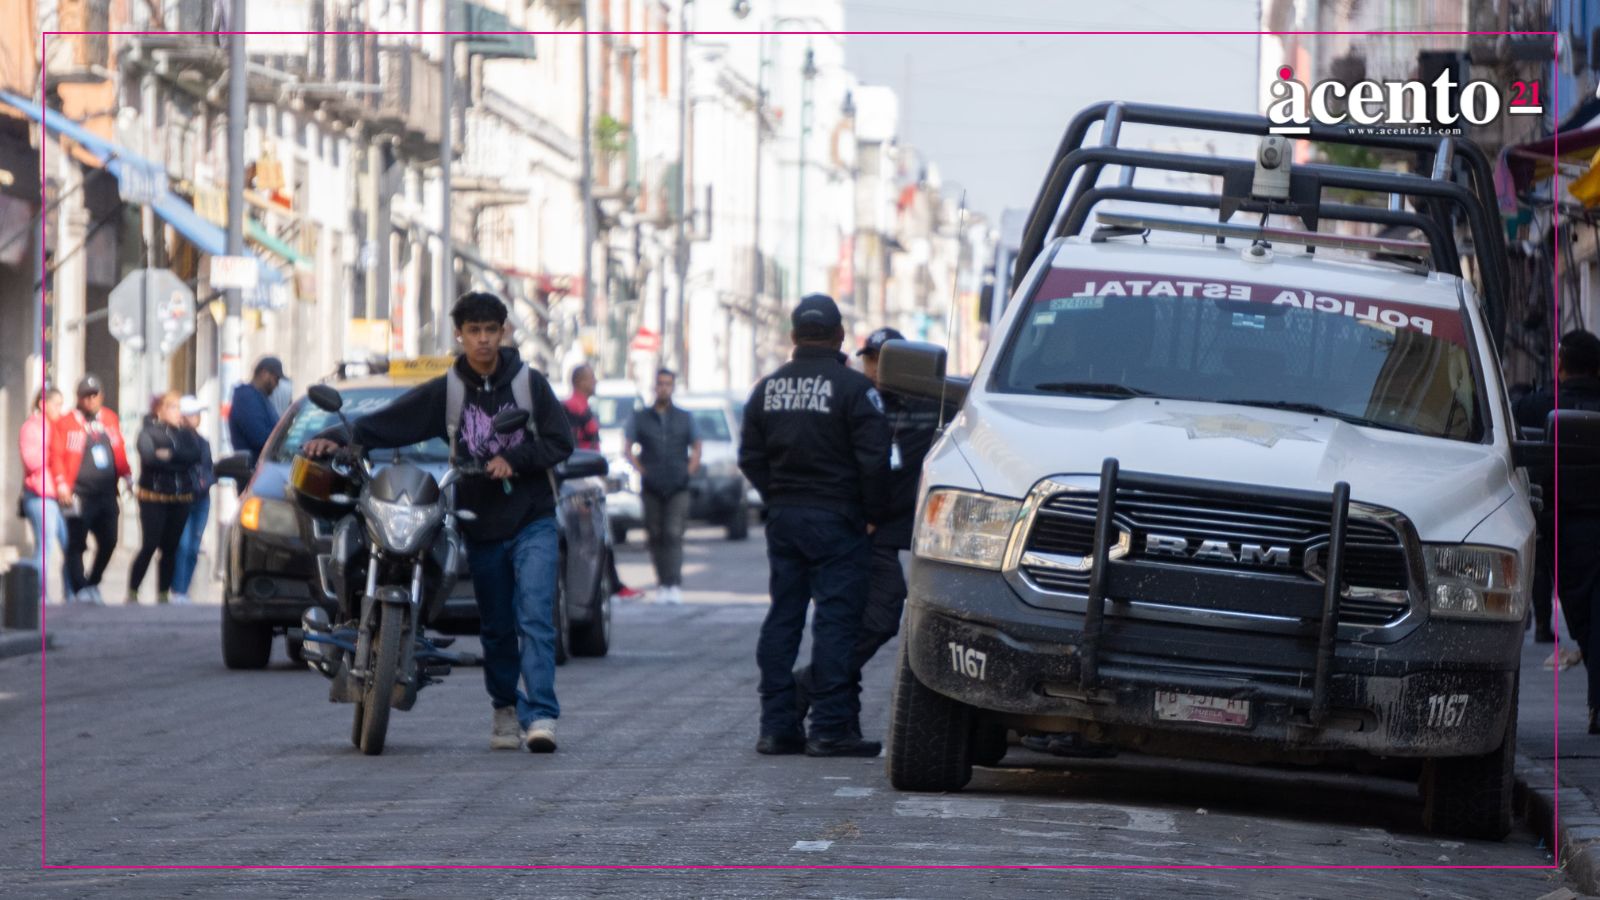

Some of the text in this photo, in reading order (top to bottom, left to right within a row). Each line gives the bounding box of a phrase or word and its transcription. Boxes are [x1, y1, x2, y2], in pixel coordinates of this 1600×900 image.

[763, 393, 831, 413] ESTATAL
[765, 375, 833, 398] POLICÍA
[1145, 533, 1290, 566] RAM
[948, 641, 987, 681] 1167
[1427, 694, 1469, 727] 1167
